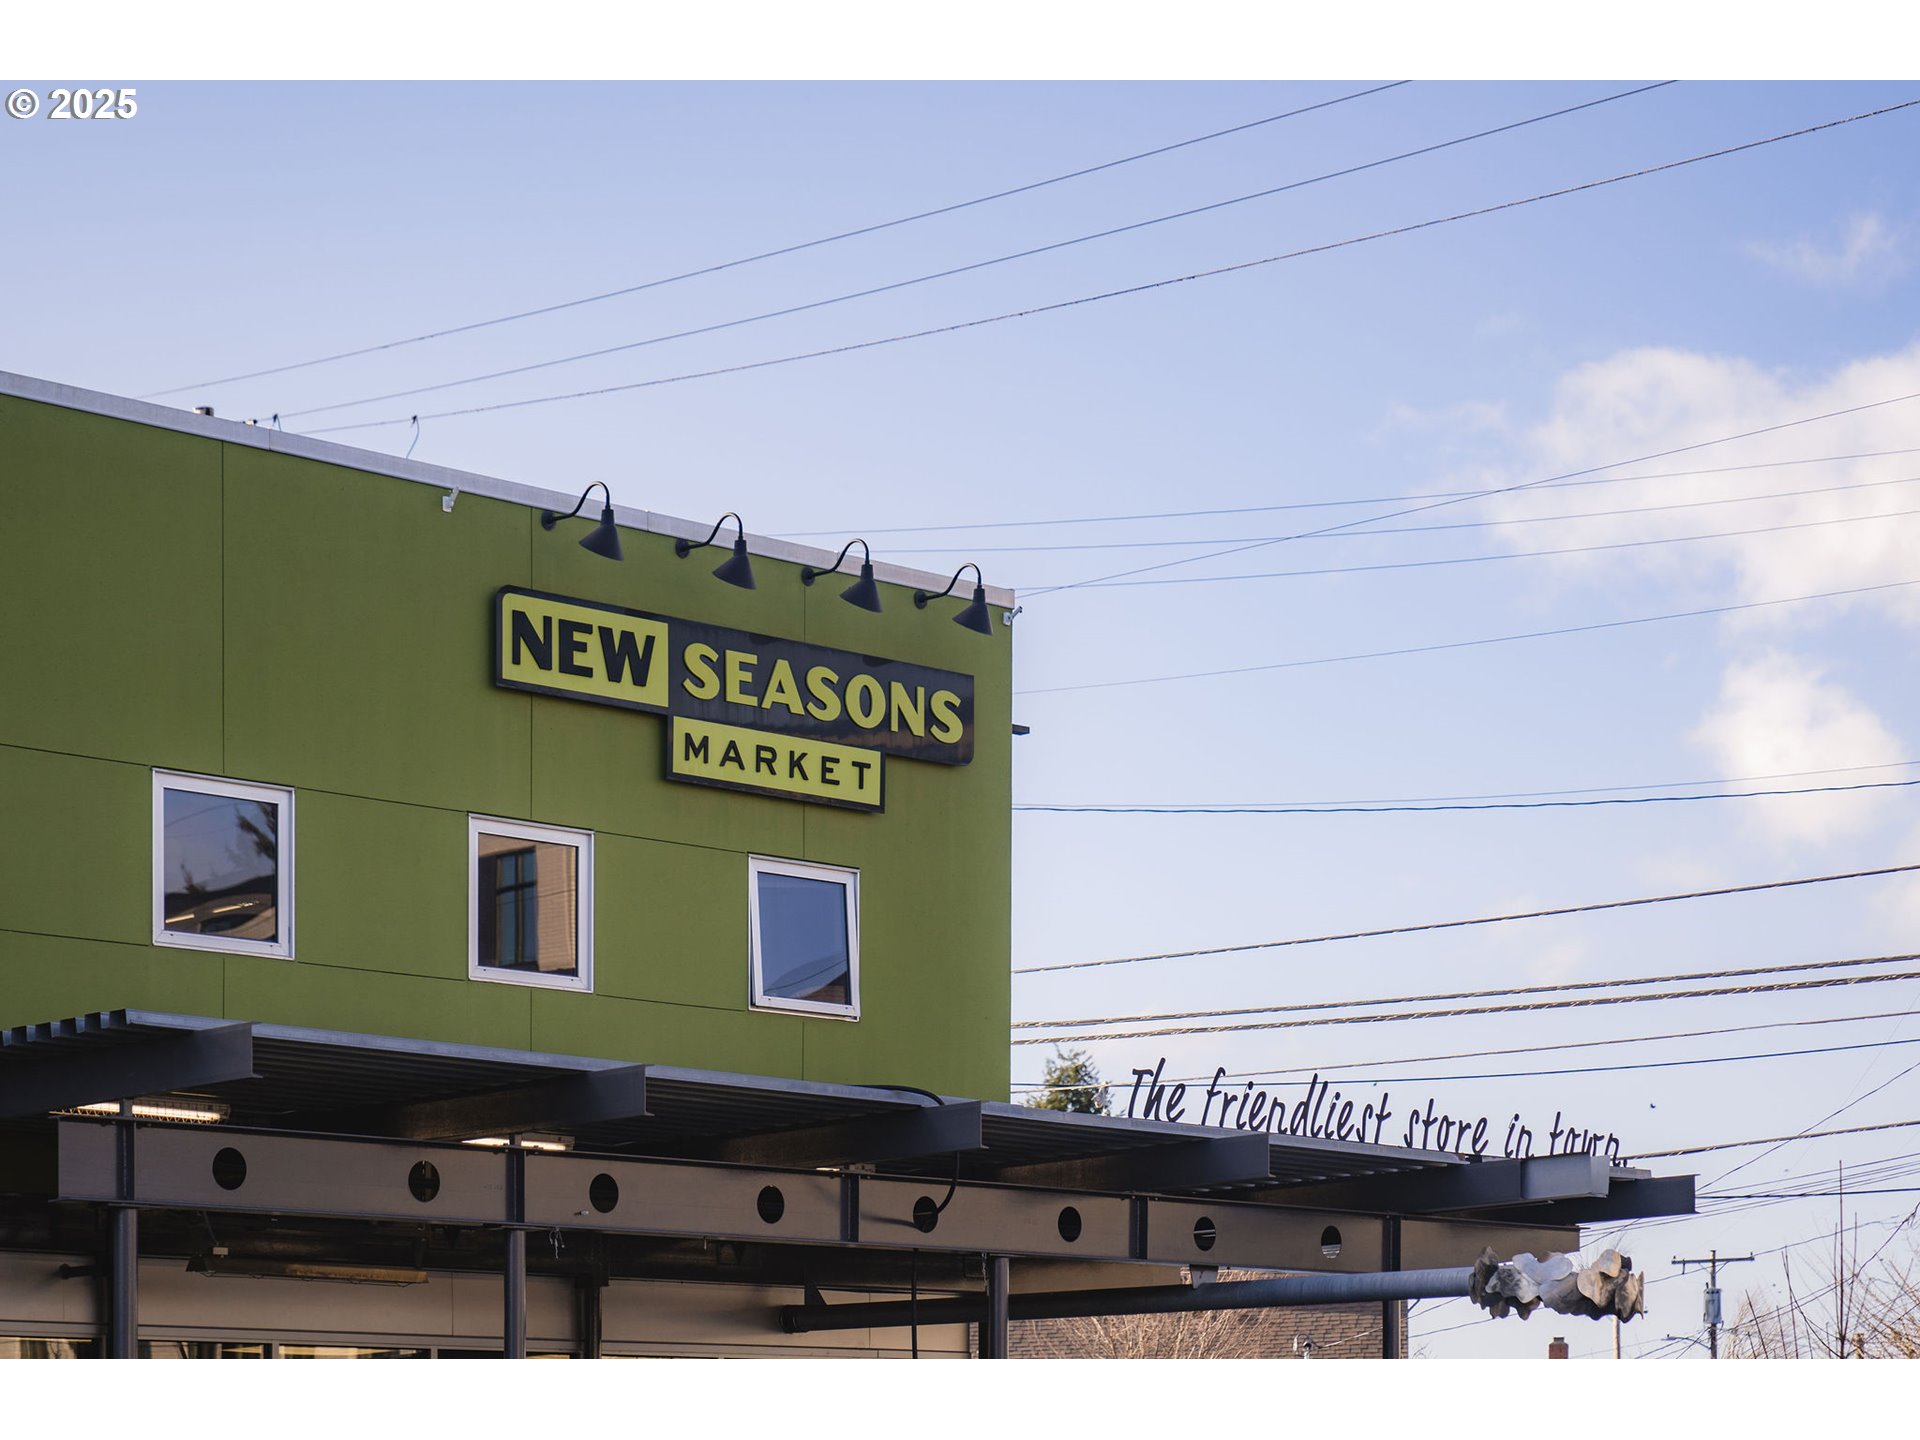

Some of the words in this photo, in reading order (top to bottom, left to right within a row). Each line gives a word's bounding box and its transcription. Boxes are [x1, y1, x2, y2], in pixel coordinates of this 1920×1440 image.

[511, 610, 656, 687] NEW
[682, 642, 964, 744] SEASONS
[684, 732, 872, 790] MARKET
[1128, 1057, 1186, 1122] The
[1201, 1067, 1392, 1144] friendliest
[1404, 1098, 1489, 1155] store
[1504, 1113, 1535, 1159] in
